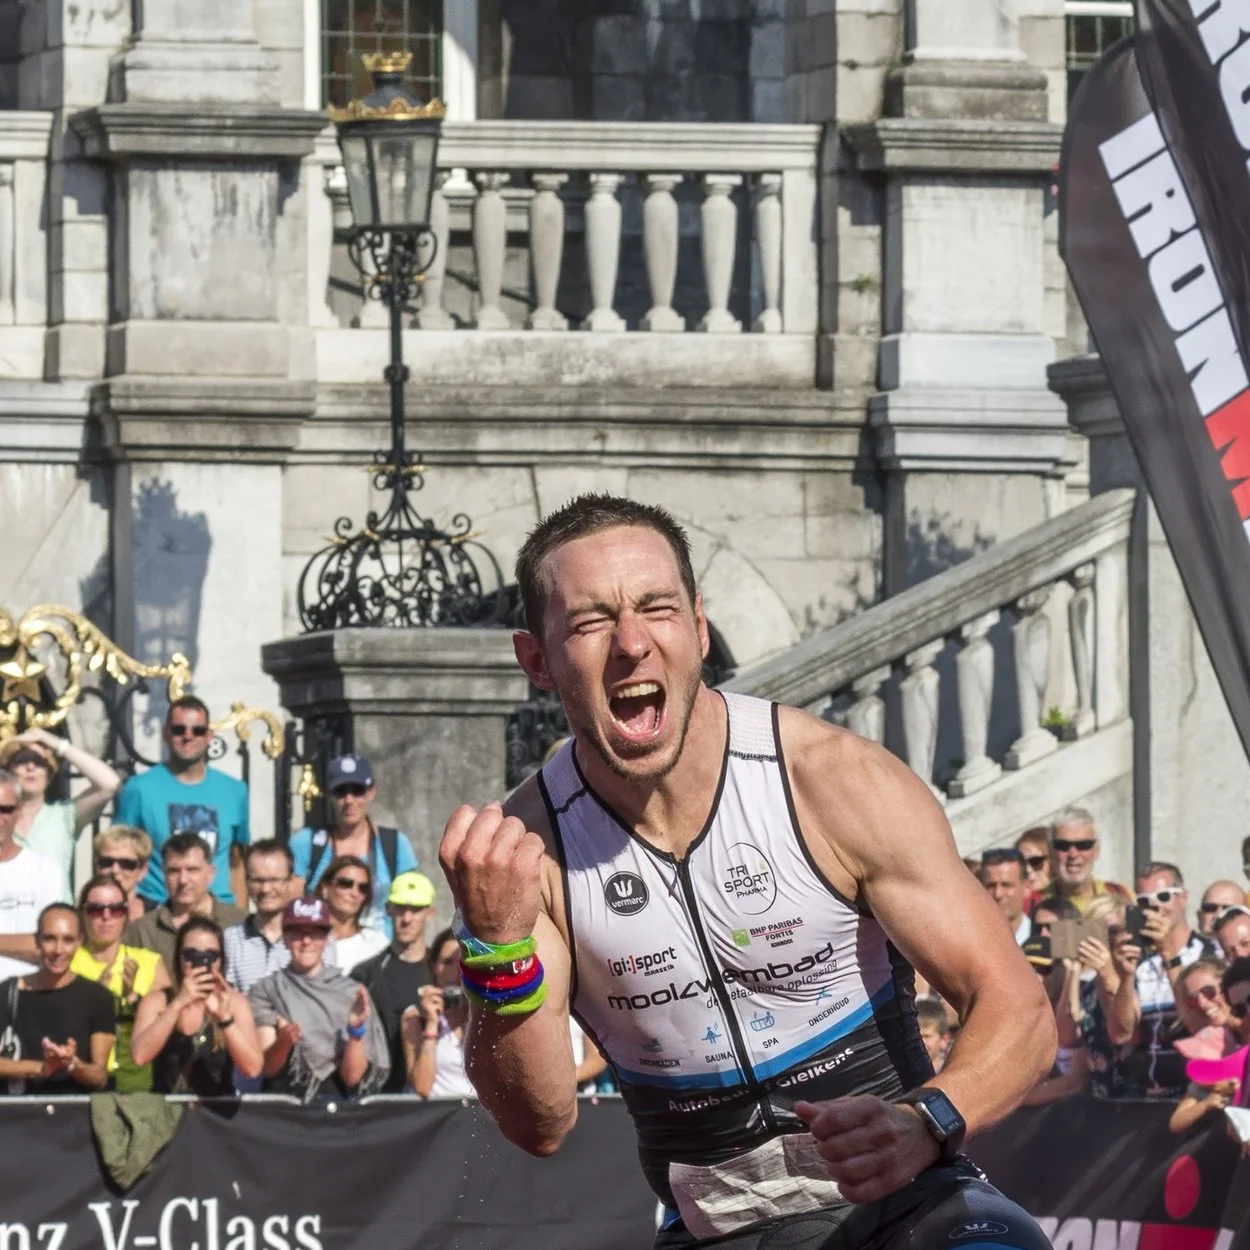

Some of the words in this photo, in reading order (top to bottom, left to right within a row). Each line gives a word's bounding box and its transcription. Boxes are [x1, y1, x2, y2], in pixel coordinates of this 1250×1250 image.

[727, 864, 749, 878] TRI
[724, 872, 769, 893] SPORT
[611, 896, 644, 908] vermarc
[749, 925, 767, 936] BNP
[768, 917, 804, 931] PARIBAS
[765, 930, 794, 941] FORTIS
[787, 959, 838, 991] oplossing
[808, 997, 850, 1028] ONDERHOUD
[762, 1036, 779, 1049] SPA
[705, 1050, 734, 1063] SAUNA
